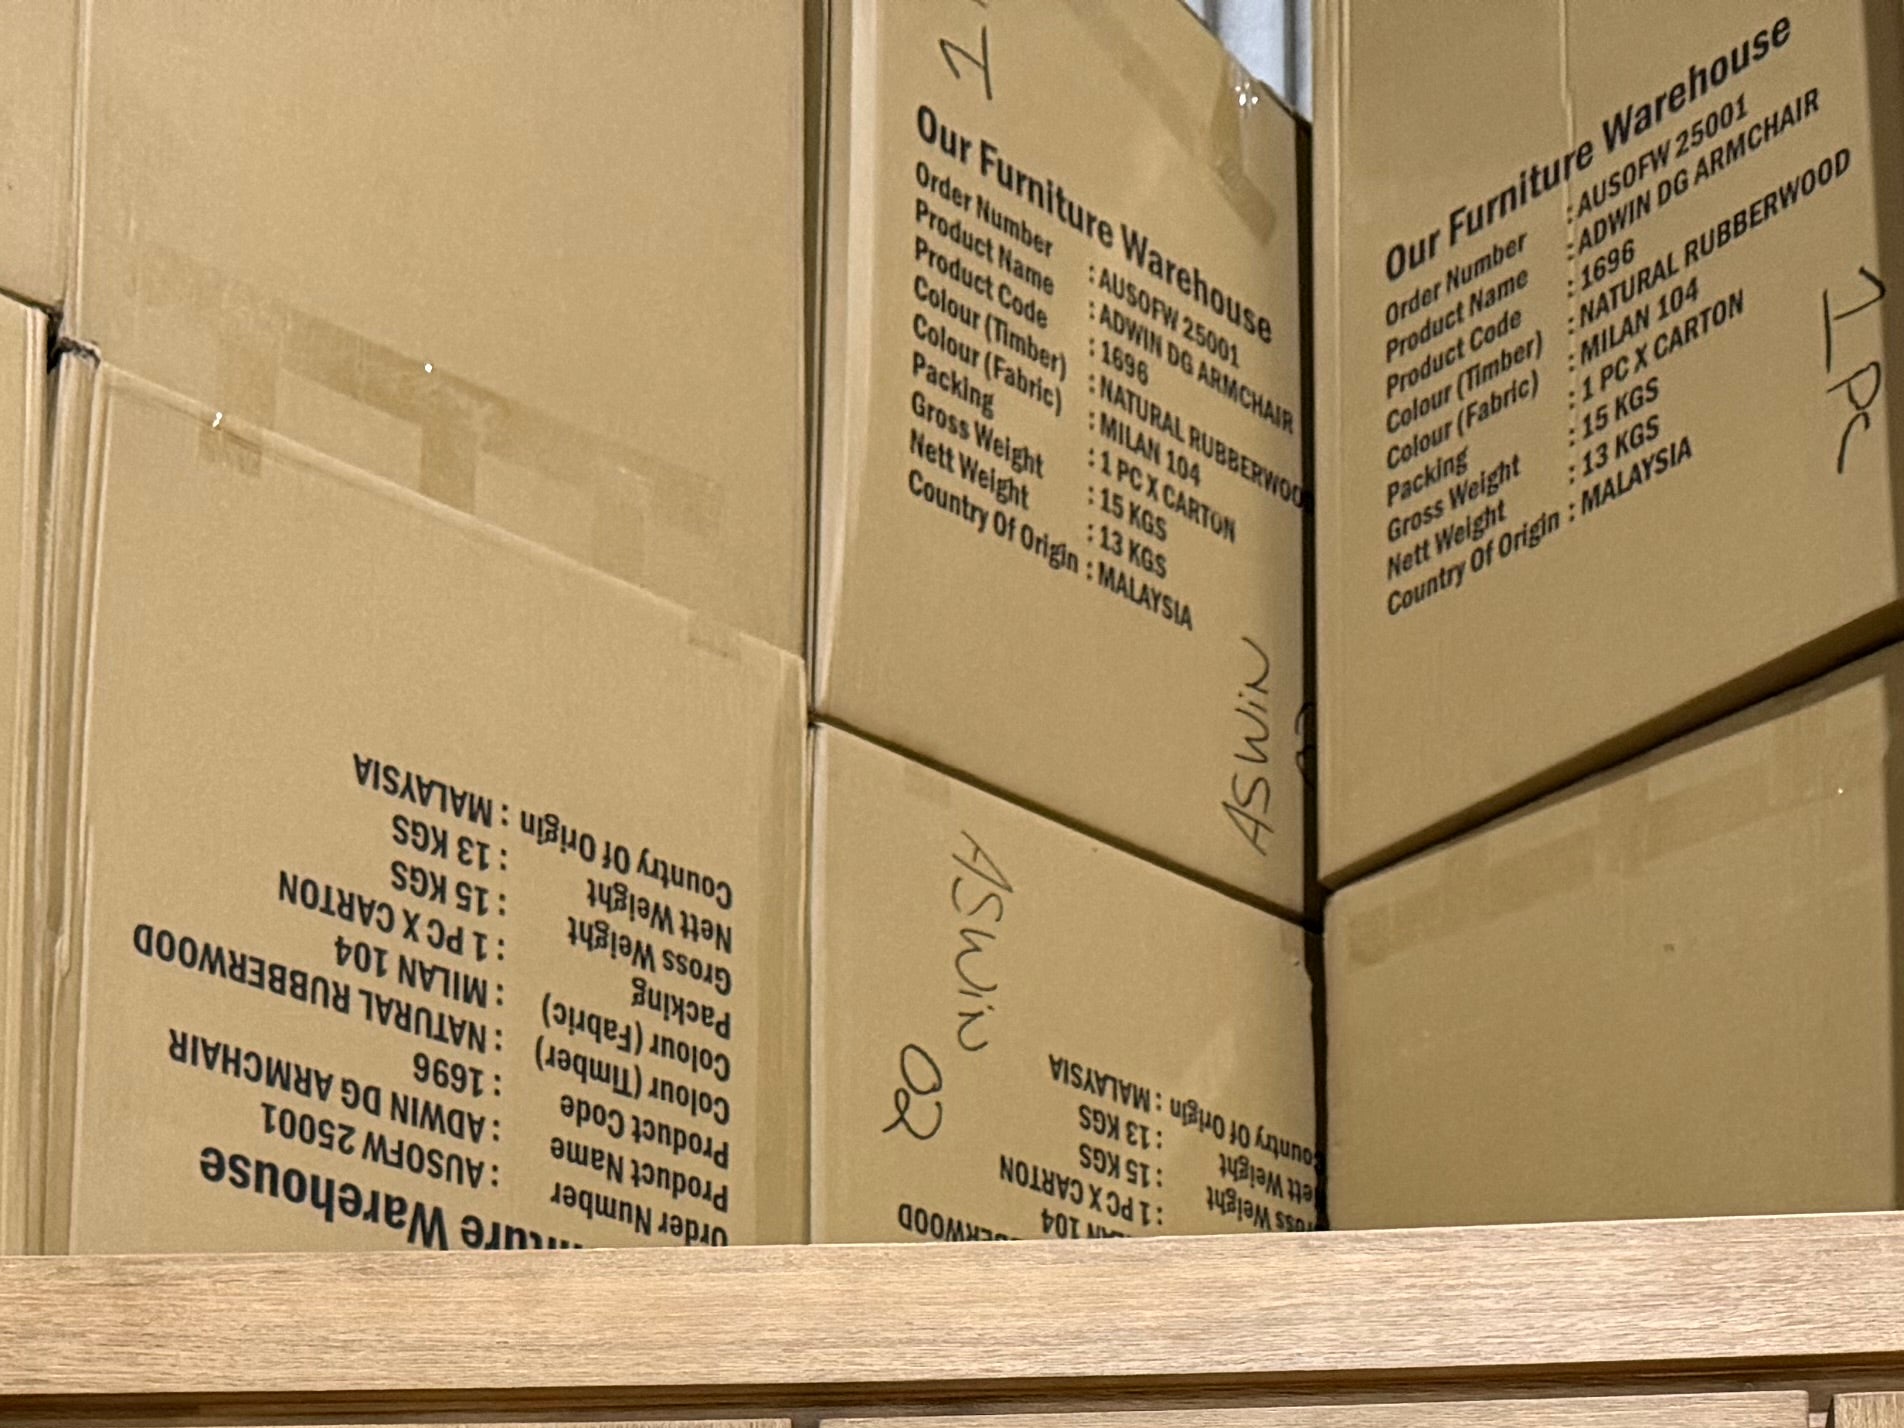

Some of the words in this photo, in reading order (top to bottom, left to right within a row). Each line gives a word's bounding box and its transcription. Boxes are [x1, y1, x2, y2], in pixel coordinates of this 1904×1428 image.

[1385, 226, 1441, 281] Our
[1448, 139, 1594, 247] Furniture
[1600, 18, 1792, 154] Warehouse
[916, 102, 973, 165] Our
[979, 138, 1114, 251] Furniture
[1120, 223, 1273, 343] Warehouse
[1386, 299, 1465, 364] Product
[1468, 269, 1527, 317] Name
[1576, 188, 1651, 256] ADWIN
[1657, 167, 1689, 207] DG
[1693, 88, 1820, 186] ARMCHAIR
[914, 158, 973, 212] Order
[976, 193, 1053, 260] Number
[1097, 268, 1179, 333] AUSOFW
[1181, 315, 1240, 369] 25001
[1387, 335, 1465, 399] Product
[1468, 309, 1521, 352] Code
[1579, 236, 1635, 291] 1696
[911, 346, 994, 421] Packing
[1099, 451, 1111, 479] 1
[1116, 457, 1142, 493] PC
[1144, 472, 1159, 503] X
[1161, 483, 1236, 542] CARTON
[1387, 499, 1444, 544] Gross
[1448, 453, 1520, 512] Weight
[1581, 401, 1608, 440] 15
[1614, 374, 1660, 421] KGS
[909, 425, 955, 474] Nett
[958, 450, 1029, 513] Weight
[1099, 525, 1124, 558] 13
[1128, 538, 1168, 580] KGS
[349, 752, 492, 828] MALAYSIA
[519, 809, 596, 862] Origin
[601, 838, 631, 874] Of
[388, 858, 446, 904] KGS
[454, 879, 488, 916] 15
[636, 845, 733, 911] Country
[332, 933, 388, 977] 104
[566, 913, 656, 973] Weight
[397, 952, 487, 1007] MILAN
[661, 947, 731, 997] Gross
[541, 988, 643, 1055] (Fabric)
[167, 1027, 334, 1101] ARMCHAIR
[647, 1031, 730, 1084] Colour
[1047, 1052, 1150, 1113] MALAYSIA
[339, 1075, 381, 1116] DG
[389, 1089, 486, 1143] ADWIN
[1077, 1102, 1119, 1140] KGS
[1169, 1096, 1225, 1140] Origin
[549, 1134, 623, 1184] Name
[1077, 1141, 1120, 1179] KGS
[1124, 1118, 1149, 1150] 13
[1228, 1118, 1251, 1149] Of
[1253, 1123, 1315, 1178] ountry
[629, 1157, 727, 1216] Product
[999, 1153, 1084, 1205] CARTON
[1087, 1182, 1102, 1212] X
[1124, 1157, 1150, 1188] 15
[1217, 1151, 1284, 1200] Weight
[1285, 1176, 1314, 1215] ett
[198, 1146, 449, 1253] Warehouse
[1105, 1189, 1133, 1222] PC
[1137, 1198, 1150, 1226] 1
[1204, 1183, 1271, 1232] Weight
